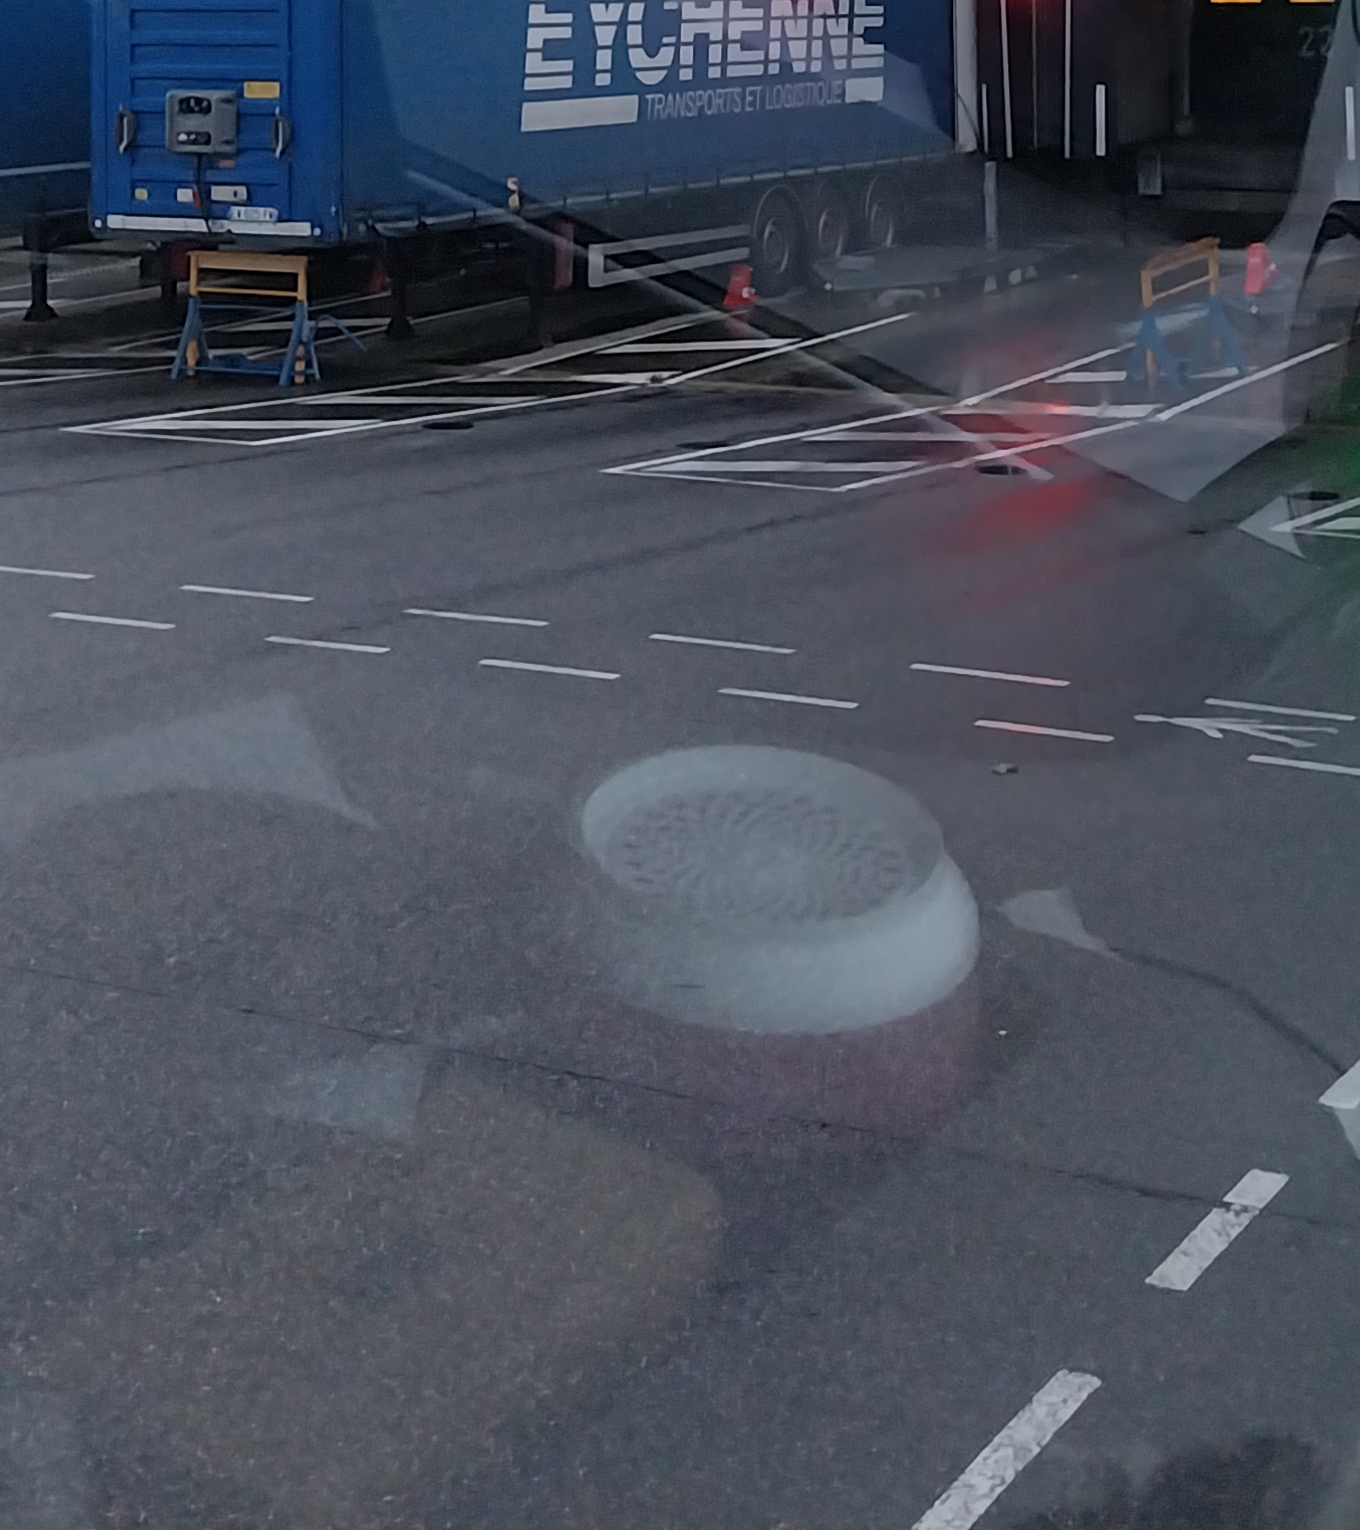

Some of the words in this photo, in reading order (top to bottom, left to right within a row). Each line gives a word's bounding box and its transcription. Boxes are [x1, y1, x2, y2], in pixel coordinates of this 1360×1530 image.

[645, 88, 742, 120] TRANSPORTS
[745, 85, 763, 112] ET
[766, 80, 843, 110] LOGISTIQUE
